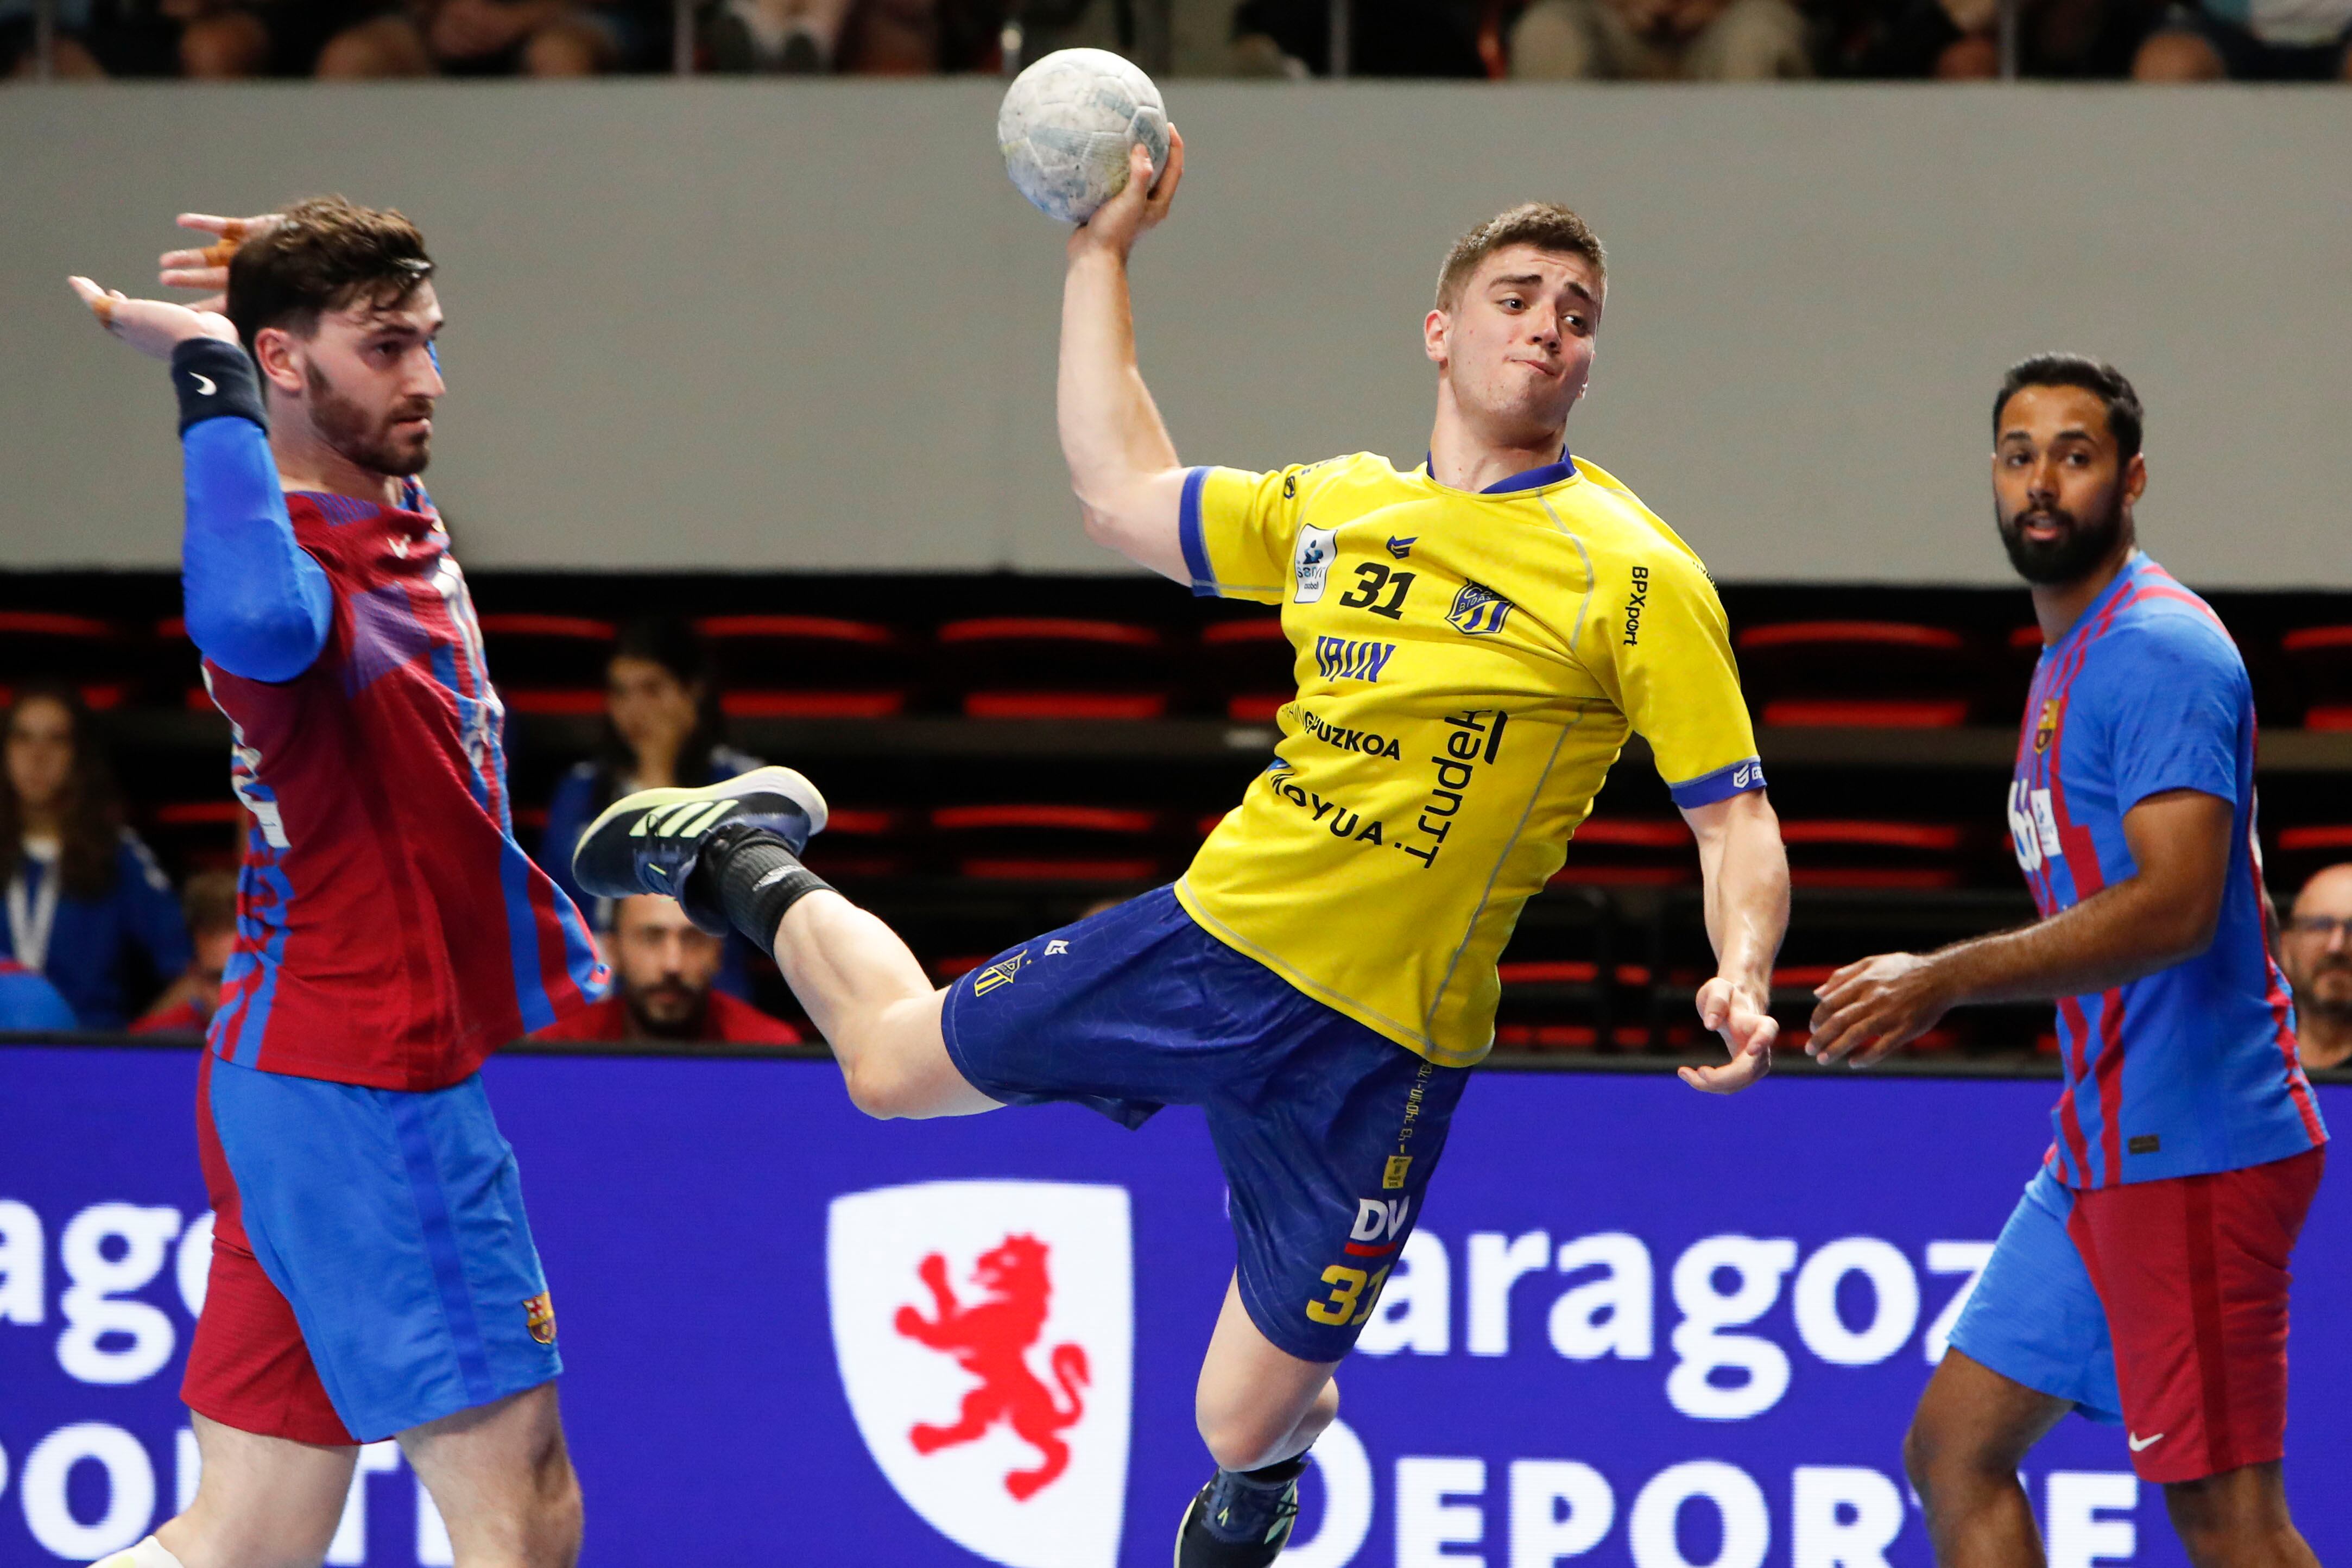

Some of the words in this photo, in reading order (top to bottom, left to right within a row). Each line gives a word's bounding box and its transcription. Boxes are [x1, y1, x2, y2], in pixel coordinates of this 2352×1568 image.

[1339, 562, 1417, 620] 31
[1316, 635, 1396, 683] IRUN
[1350, 1196, 1410, 1242] DV
[1306, 1264, 1390, 1326] 31
